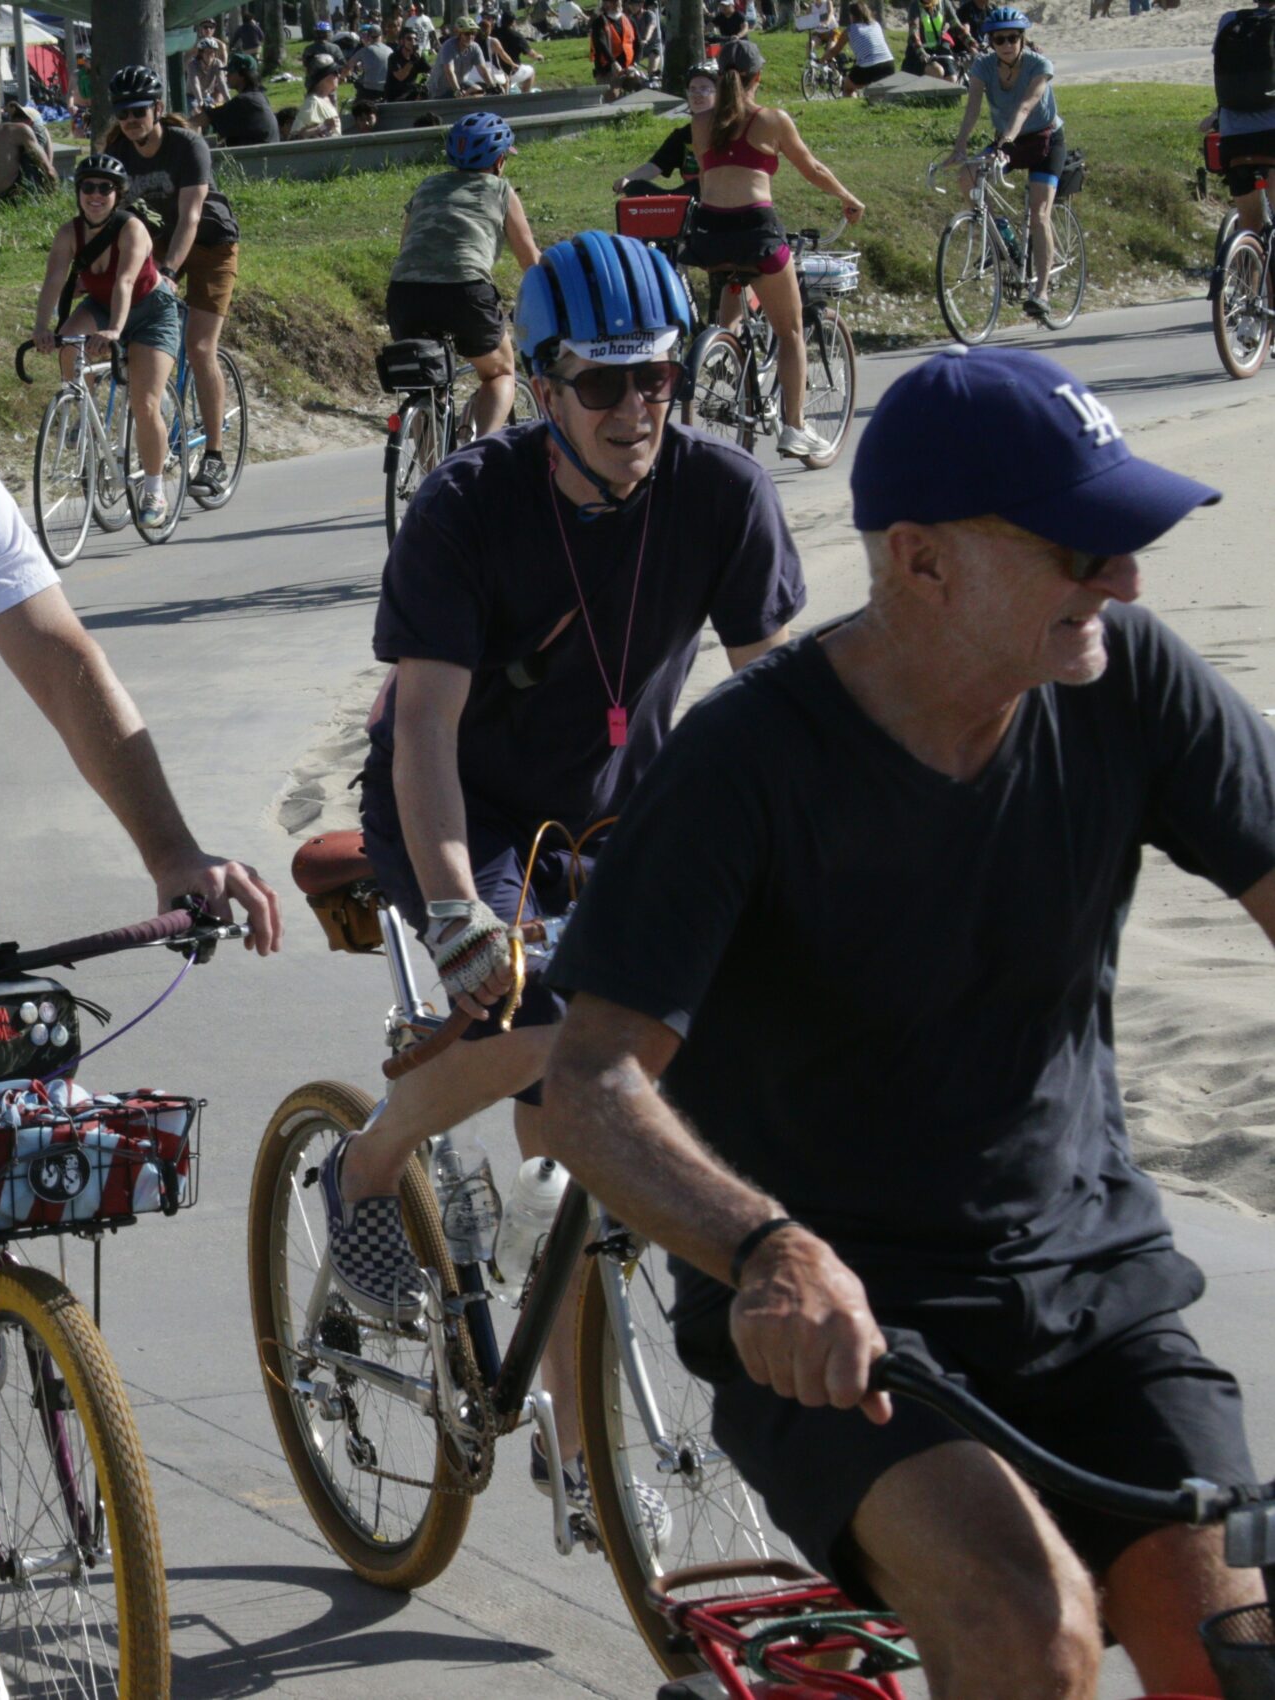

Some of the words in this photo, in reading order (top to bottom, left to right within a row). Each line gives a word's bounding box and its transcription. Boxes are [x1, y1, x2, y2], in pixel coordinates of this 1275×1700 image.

[638, 207, 676, 215] DOORDASH
[590, 346, 607, 358] no
[608, 341, 656, 355] hands!
[1053, 383, 1123, 447] LA
